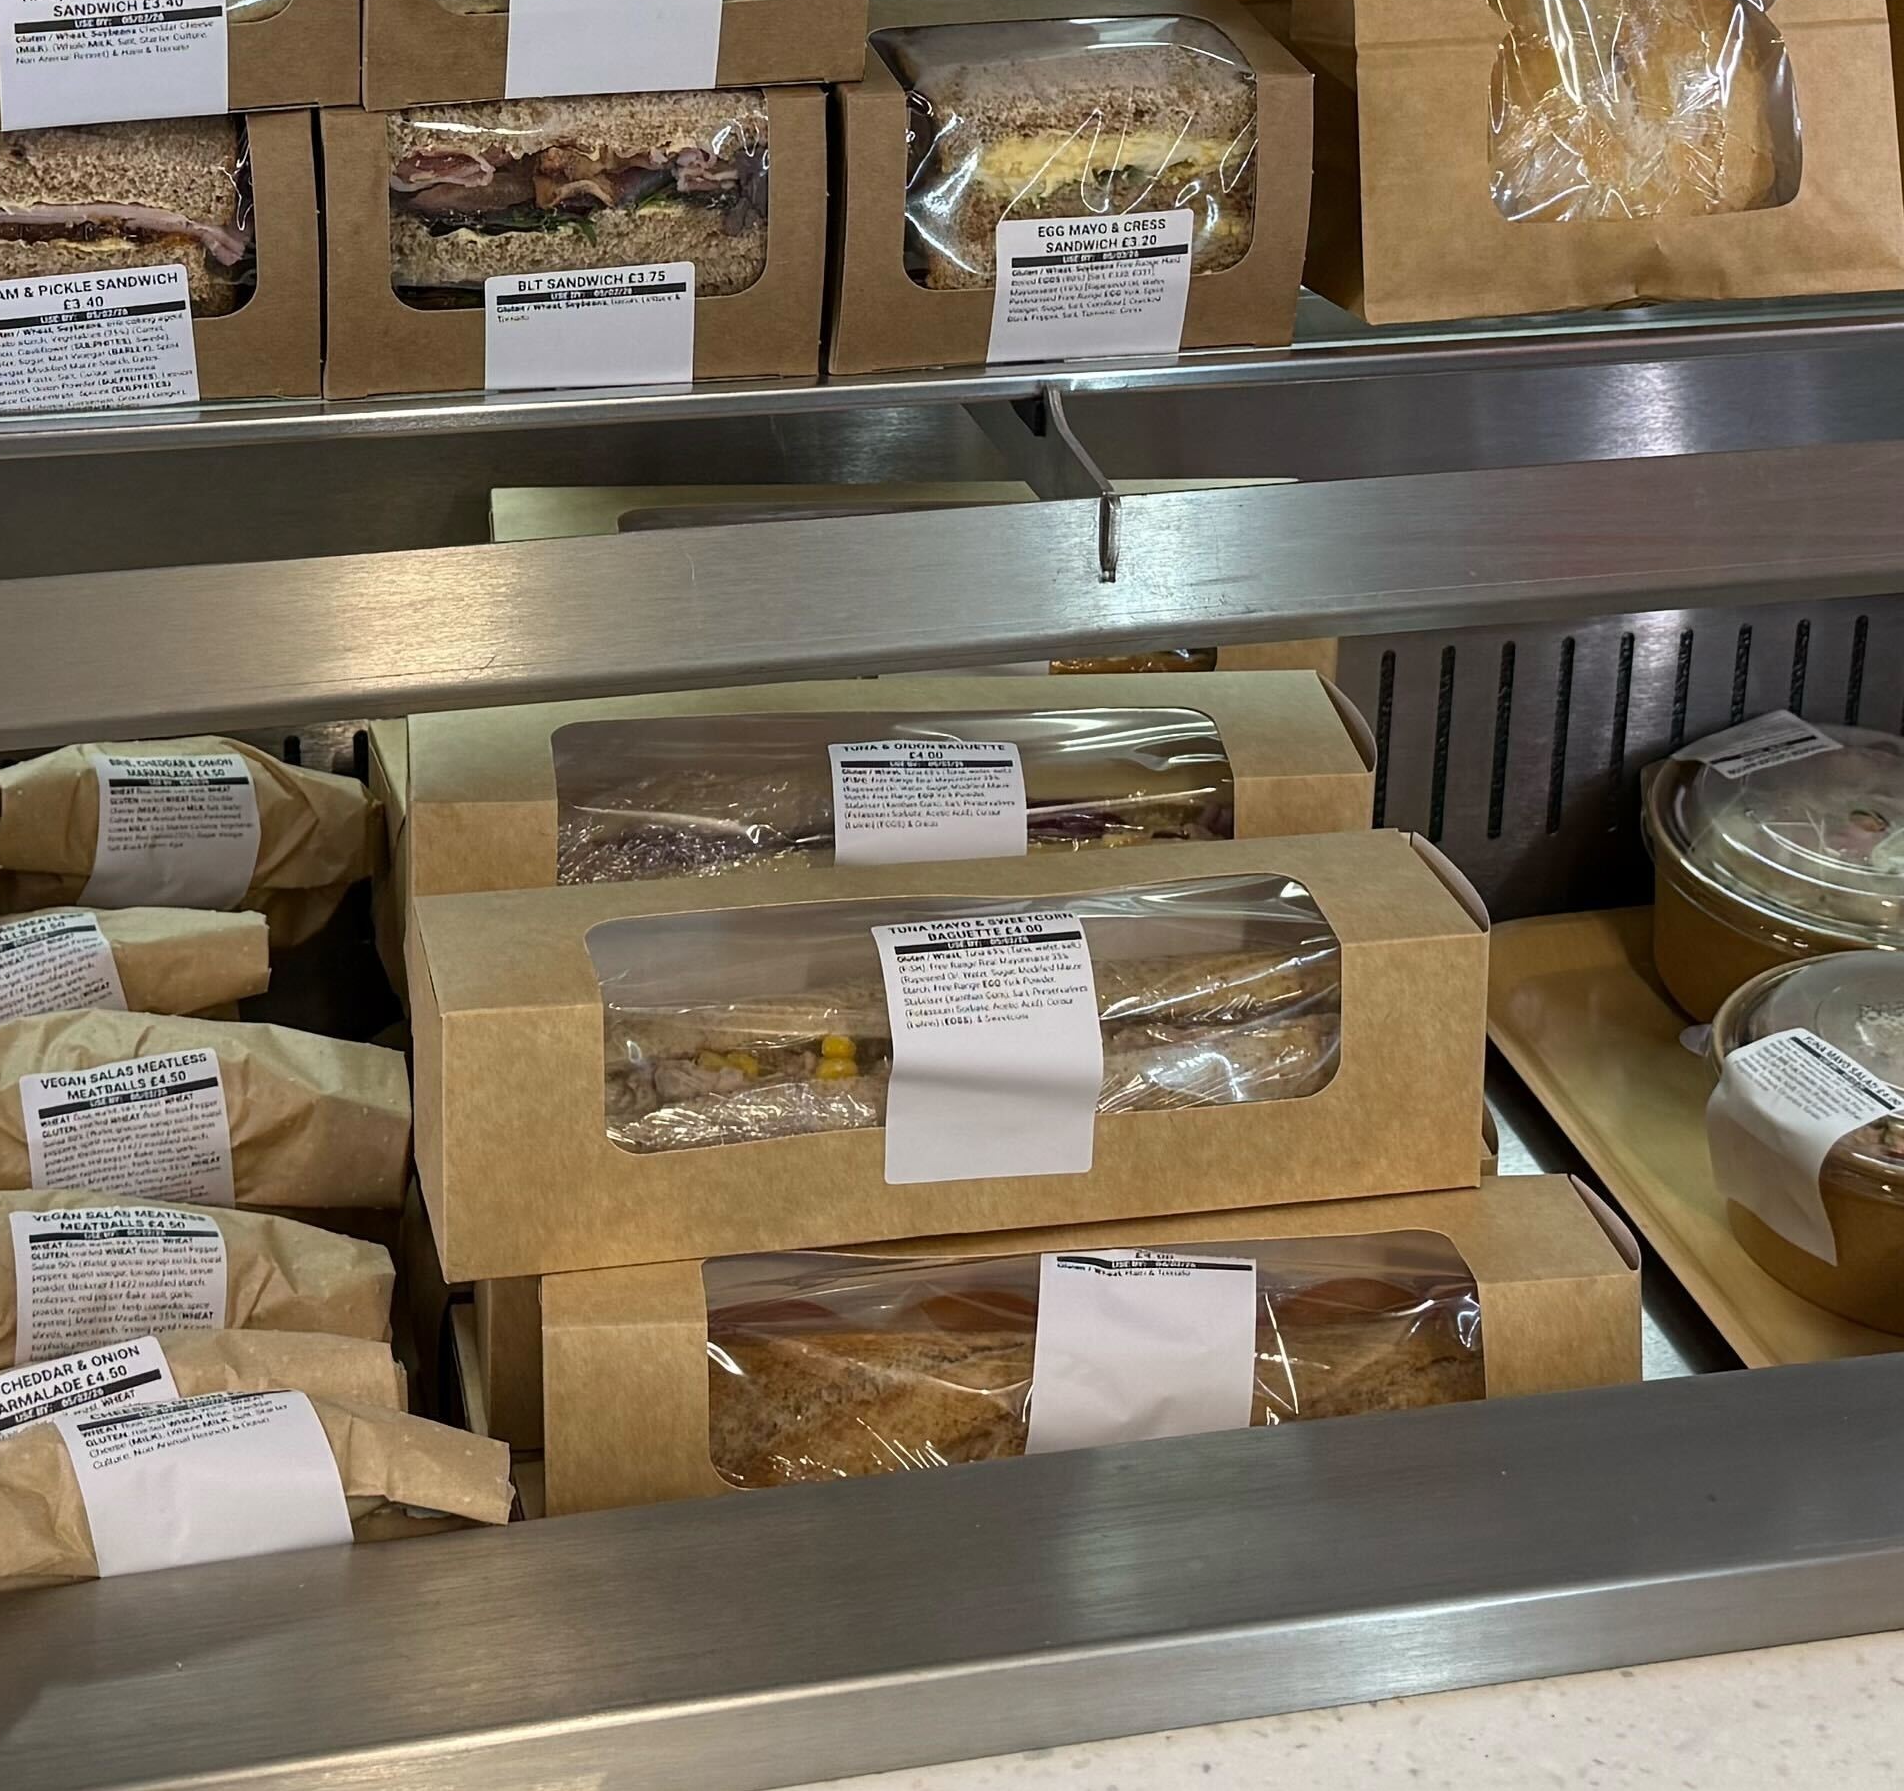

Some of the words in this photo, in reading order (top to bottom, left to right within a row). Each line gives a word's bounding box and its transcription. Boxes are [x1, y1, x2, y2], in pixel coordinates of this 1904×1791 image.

[53, 0, 138, 18] SANDWICH
[1037, 226, 1065, 238] EGG
[1069, 223, 1107, 236] MAYO
[1111, 222, 1119, 233] &
[1123, 219, 1166, 232] CRESS
[1046, 238, 1118, 253] SANDWICH
[24, 286, 34, 298] &
[39, 280, 92, 296] PICKLE
[96, 272, 178, 291] SANDWICH
[518, 279, 543, 292] BLT
[547, 274, 624, 289] SANDWICH
[628, 271, 666, 284] £3.75
[63, 296, 104, 310] £3.40
[888, 924, 928, 935] TUNA
[931, 920, 971, 932] MAYO
[988, 913, 1073, 926] SWEETCORN
[928, 928, 1001, 942] BAGUETTE
[40, 1076, 86, 1090] VEGAN
[90, 1066, 134, 1083] SALAS
[137, 1053, 207, 1075] MEATLESS
[67, 1079, 147, 1100] MEATBALLS
[150, 1070, 186, 1088] £4.50
[60, 1219, 145, 1231] MEATBALLS
